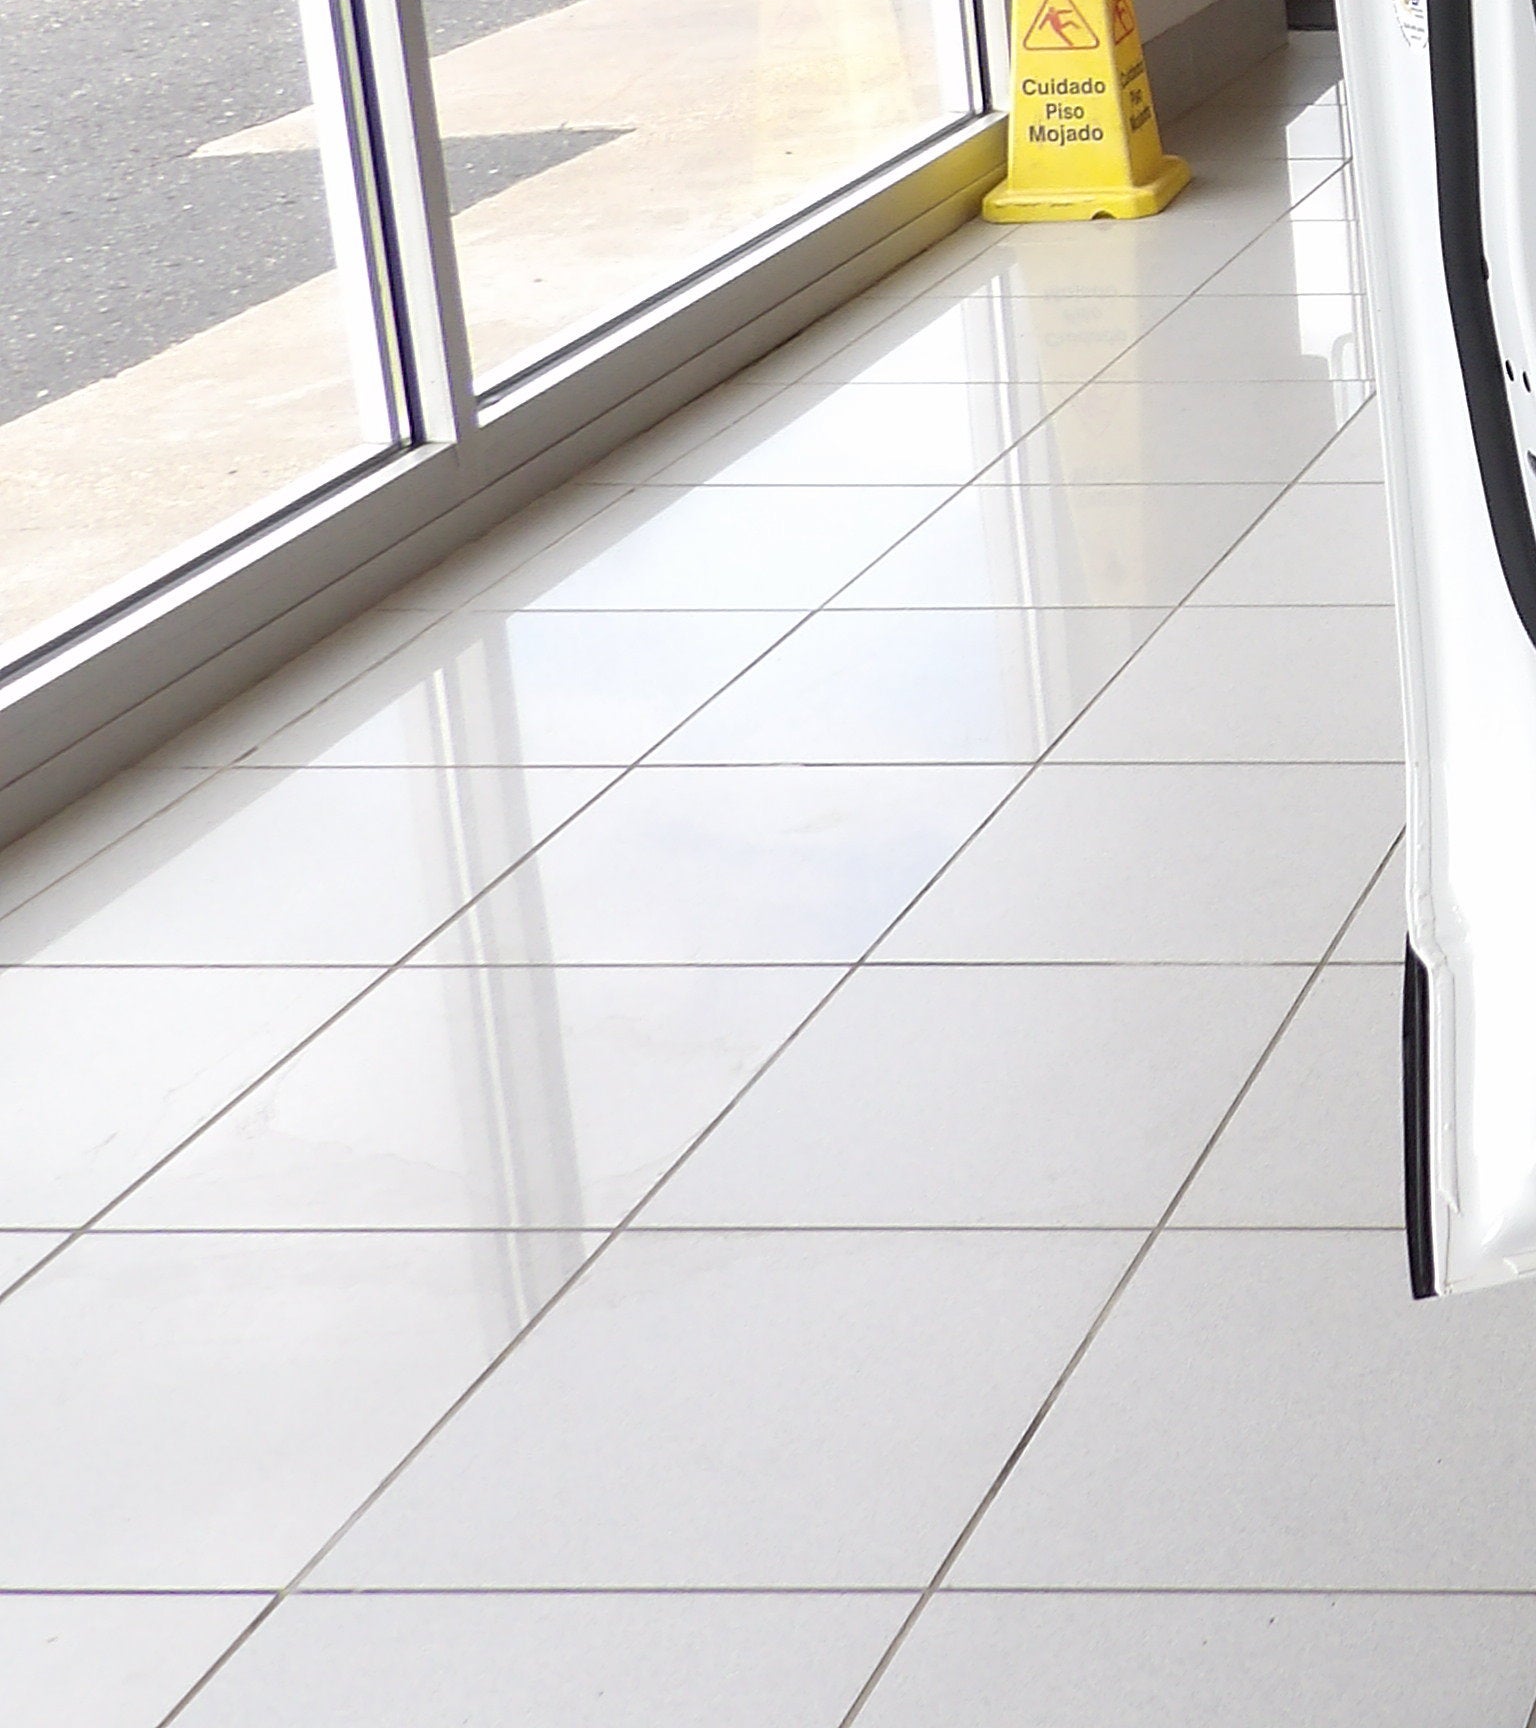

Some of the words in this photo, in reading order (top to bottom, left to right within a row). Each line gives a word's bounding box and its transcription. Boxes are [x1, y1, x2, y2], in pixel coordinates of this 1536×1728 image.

[1021, 77, 1107, 95] Cuidado
[1045, 102, 1086, 120] Piso
[1028, 124, 1105, 147] Mojado
